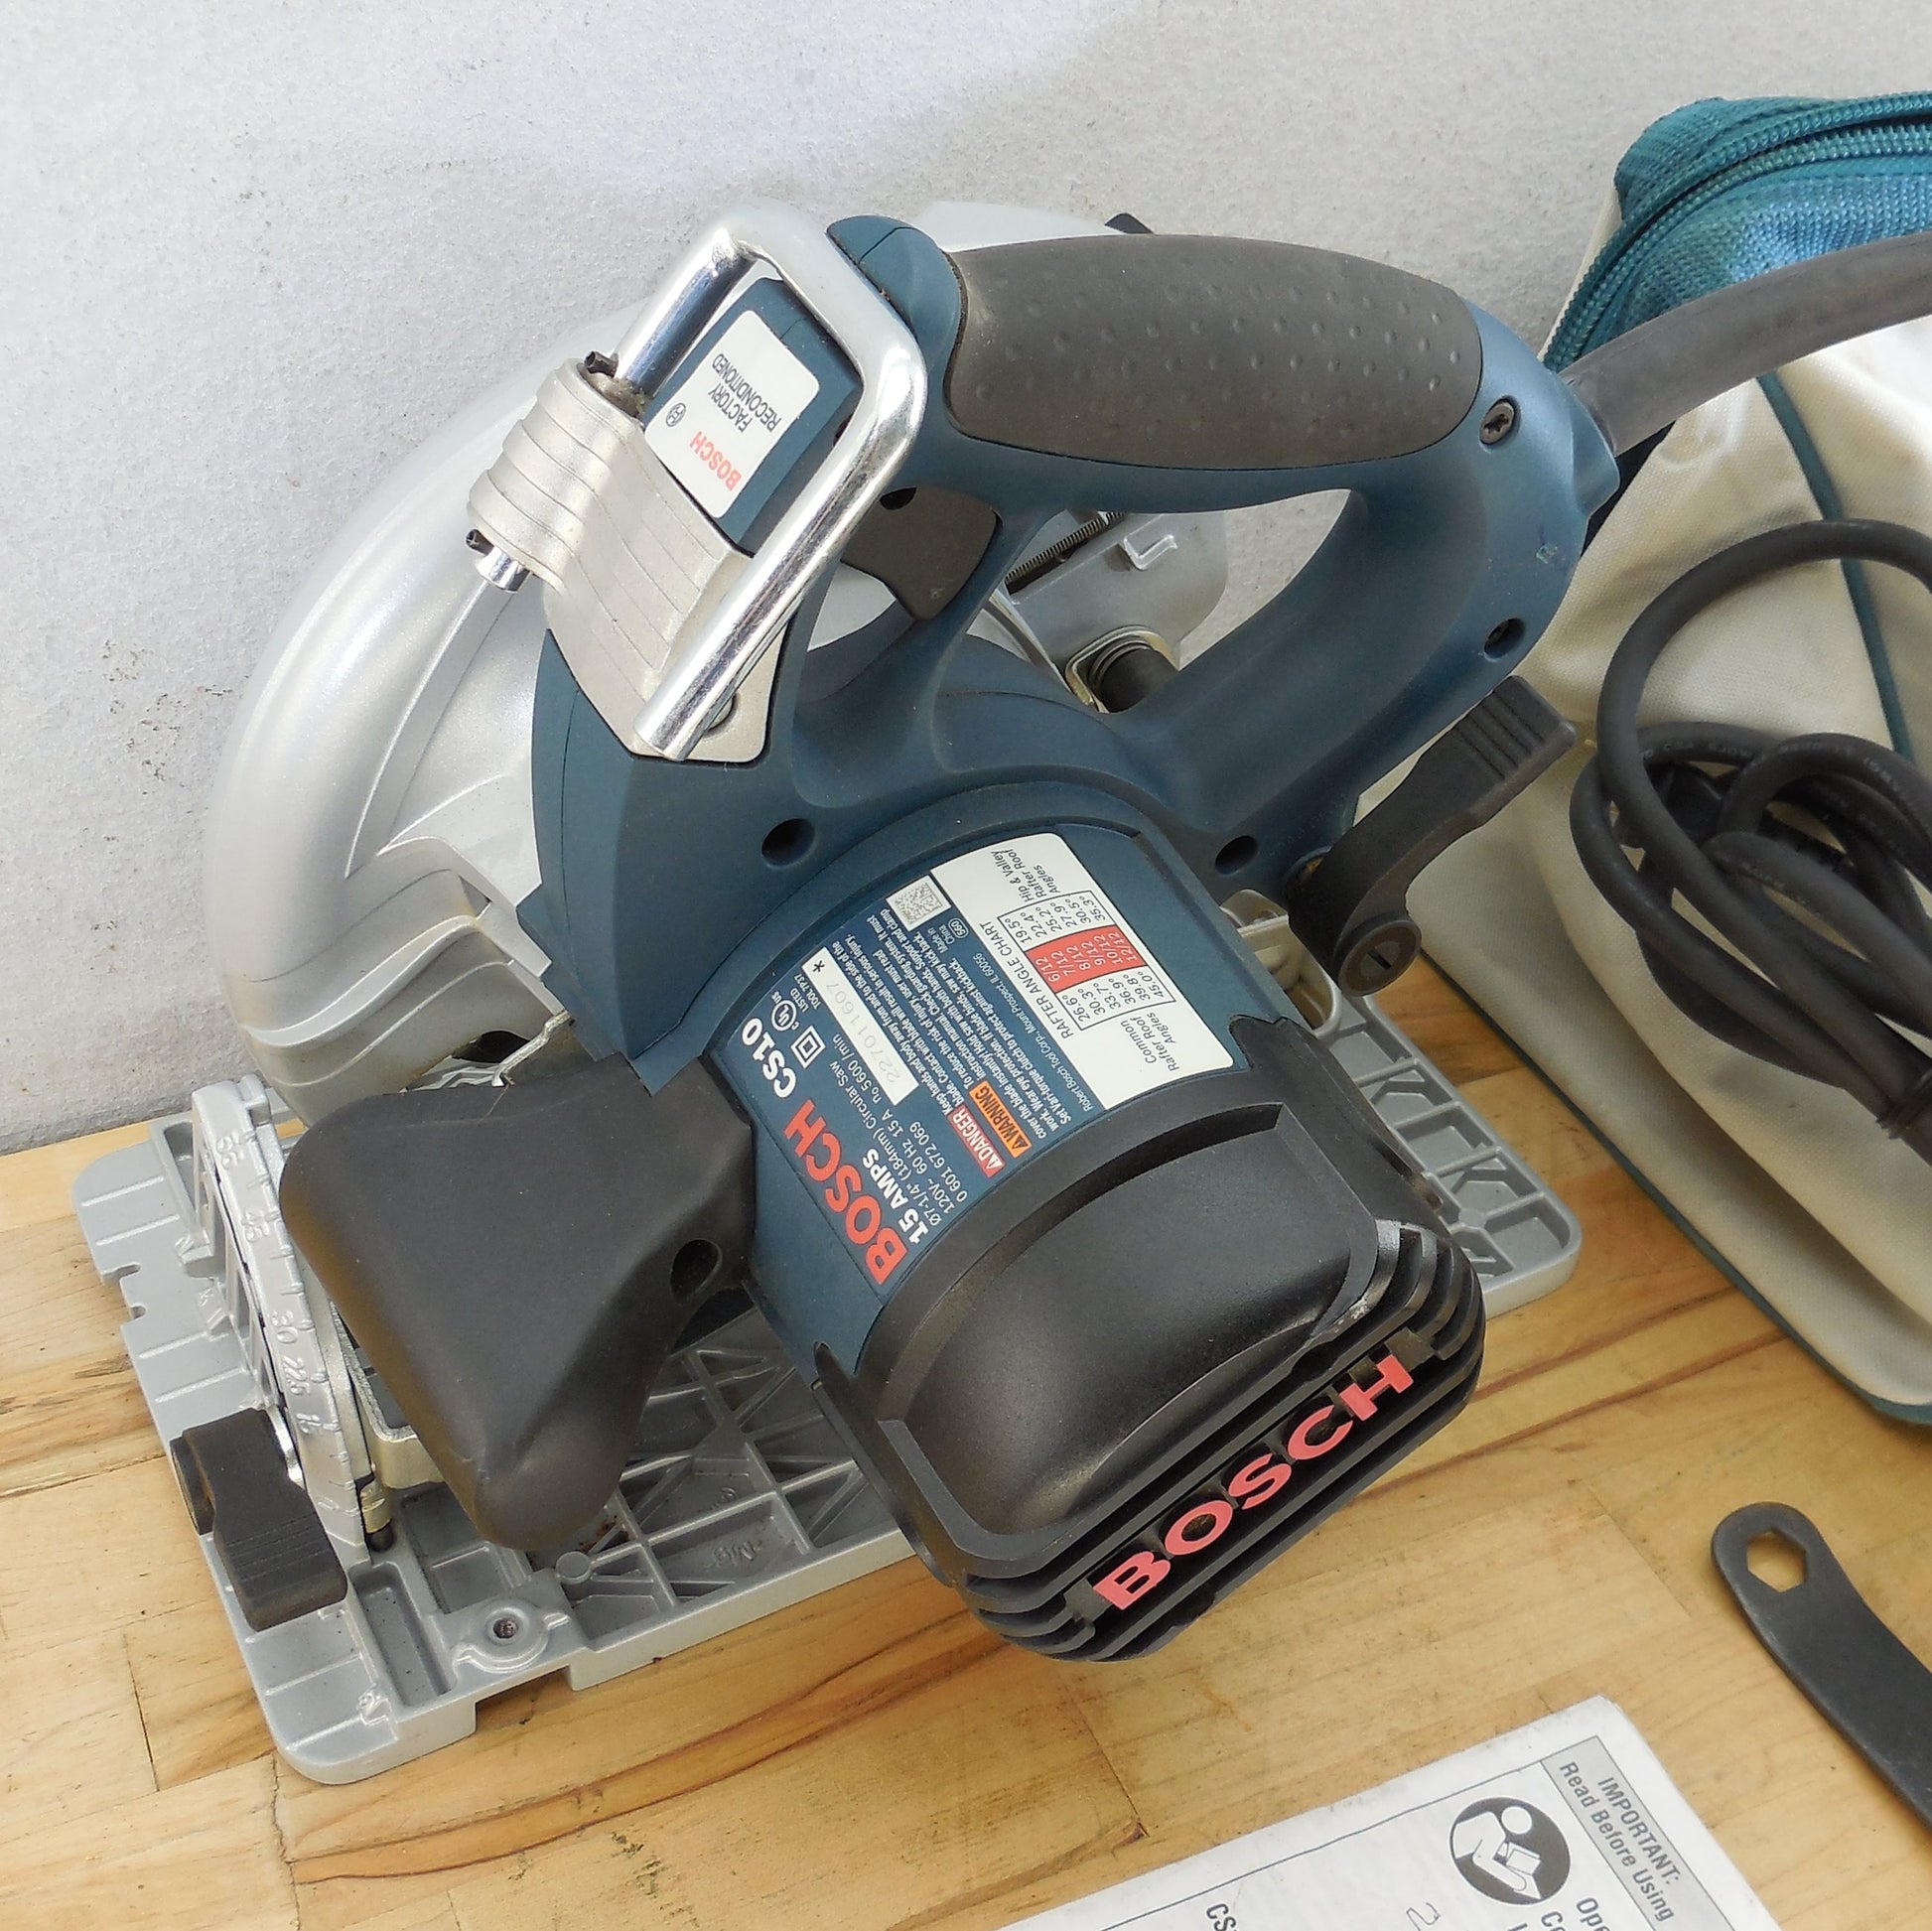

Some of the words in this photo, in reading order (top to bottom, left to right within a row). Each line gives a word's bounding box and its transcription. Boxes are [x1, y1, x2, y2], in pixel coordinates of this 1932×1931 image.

[712, 352, 782, 433] RECONDITIONED
[708, 383, 750, 433] FACTORY
[689, 430, 743, 491] BOSCH
[990, 849, 1014, 878] Valley
[1002, 848, 1026, 870] Roof
[1020, 870, 1047, 897] Rafter
[1033, 864, 1060, 894] Angles
[1017, 885, 1035, 902] Hip
[866, 913, 885, 933] must
[879, 907, 898, 930] clamp
[877, 929, 889, 941] It
[890, 927, 907, 943] and
[911, 930, 930, 953] back.
[931, 933, 948, 954] Made
[937, 923, 955, 944] China
[978, 920, 1013, 956] CHART
[1107, 931, 1138, 961] 12/12
[831, 940, 844, 956] the
[836, 951, 850, 962] of
[844, 933, 863, 960] injury.
[872, 948, 891, 967] read
[884, 936, 905, 964] system.
[900, 939, 926, 970] Support
[922, 948, 941, 968] kick
[1065, 944, 1091, 970] 8/12
[1080, 940, 1106, 966] 9/12
[1092, 933, 1123, 964] 10/12
[844, 959, 860, 976] side
[857, 954, 880, 981] serious
[884, 963, 902, 984] must
[934, 962, 951, 980] may
[947, 956, 976, 993] kickback.
[972, 952, 995, 977] 60056
[1006, 956, 1041, 994] ANGLE
[1035, 955, 1060, 982] 6/12
[1049, 949, 1076, 976] 7/12
[854, 973, 867, 989] the
[874, 978, 885, 991] in
[899, 960, 928, 994] guarding
[921, 966, 942, 993] hands.
[944, 977, 960, 994] saw
[989, 973, 1000, 984] IL
[789, 987, 809, 1013] LISTED
[805, 987, 821, 1010] TOOL
[862, 984, 872, 997] to
[864, 992, 882, 1009] and
[878, 985, 897, 1008] result
[896, 981, 912, 999] user
[934, 988, 953, 1009] both
[968, 988, 994, 1016] against
[995, 980, 1022, 1014] Prospect,
[890, 1005, 906, 1021] will
[907, 994, 928, 1023] injury,
[918, 990, 940, 1016] Check
[946, 1004, 964, 1023] with
[955, 990, 976, 1017] binds,
[876, 1005, 893, 1027] from
[918, 1017, 933, 1029] of
[933, 1011, 960, 1042] manual.
[957, 1020, 974, 1036] saw
[969, 1012, 989, 1035] blade
[987, 1013, 1015, 1041] protect
[1015, 1010, 1036, 1034] Mount
[1035, 994, 1074, 1038] RAFTER
[1128, 1016, 1156, 1039] Roof
[1146, 1011, 1175, 1043] Angles
[887, 1021, 904, 1042] away
[900, 1017, 919, 1041] blade
[926, 1025, 943, 1042] risk
[980, 1031, 994, 1041] If
[1119, 1019, 1157, 1063] Common
[832, 1033, 855, 1061] /min
[898, 1038, 916, 1062] body
[912, 1035, 930, 1055] with
[937, 1038, 951, 1055] the
[965, 1034, 986, 1054] Hold
[1006, 1038, 1018, 1050] to
[1151, 1040, 1180, 1071] Rafter
[741, 1017, 796, 1098] CS10
[908, 1056, 926, 1074] and
[923, 1051, 949, 1083] Contact
[945, 1050, 969, 1078] reduce
[954, 1038, 987, 1081] instruction
[977, 1049, 1009, 1088] instantly!
[989, 1036, 1024, 1078] protection.
[1011, 1045, 1034, 1070] clutch
[1043, 1050, 1061, 1069] Tool
[829, 1060, 849, 1087] Saw
[847, 1058, 872, 1091] 5600
[920, 1070, 941, 1097] hands
[962, 1075, 974, 1089] To
[1015, 1074, 1031, 1091] eye
[1055, 1064, 1077, 1089] Bosch
[945, 1079, 965, 1107] blade.
[1003, 1082, 1024, 1108] blade
[1024, 1088, 1043, 1112] Wear
[1028, 1068, 1061, 1112] Vari-torque
[1070, 1084, 1094, 1112] Robert
[844, 1084, 877, 1129] Circular
[881, 1108, 894, 1121] A
[935, 1092, 953, 1116] Keep
[974, 1085, 1019, 1143] WARNING
[1018, 1102, 1033, 1120] the
[1054, 1107, 1071, 1124] Set
[887, 1119, 903, 1138] 15
[1026, 1116, 1046, 1139] cover
[1038, 1107, 1059, 1132] work.
[908, 1121, 929, 1146] 069
[952, 1107, 994, 1162] DANGER
[872, 1127, 912, 1181] (184mm)
[901, 1137, 917, 1159] Hz
[923, 1142, 945, 1169] 672
[911, 1156, 927, 1174] 60
[862, 1148, 908, 1209] AMPS
[939, 1166, 961, 1191] 601
[784, 1101, 906, 1283] BOSCH
[955, 1189, 968, 1202] 0
[897, 1207, 928, 1244] 15
[272, 1310, 298, 1343] 30
[1093, 1354, 1414, 1610] BOSCH
[1560, 1761, 1599, 1808] Read
[1590, 1809, 1636, 1866] Before
[1632, 1868, 1674, 1922] Using
[1597, 1776, 1681, 1885] IMPORTANT:
